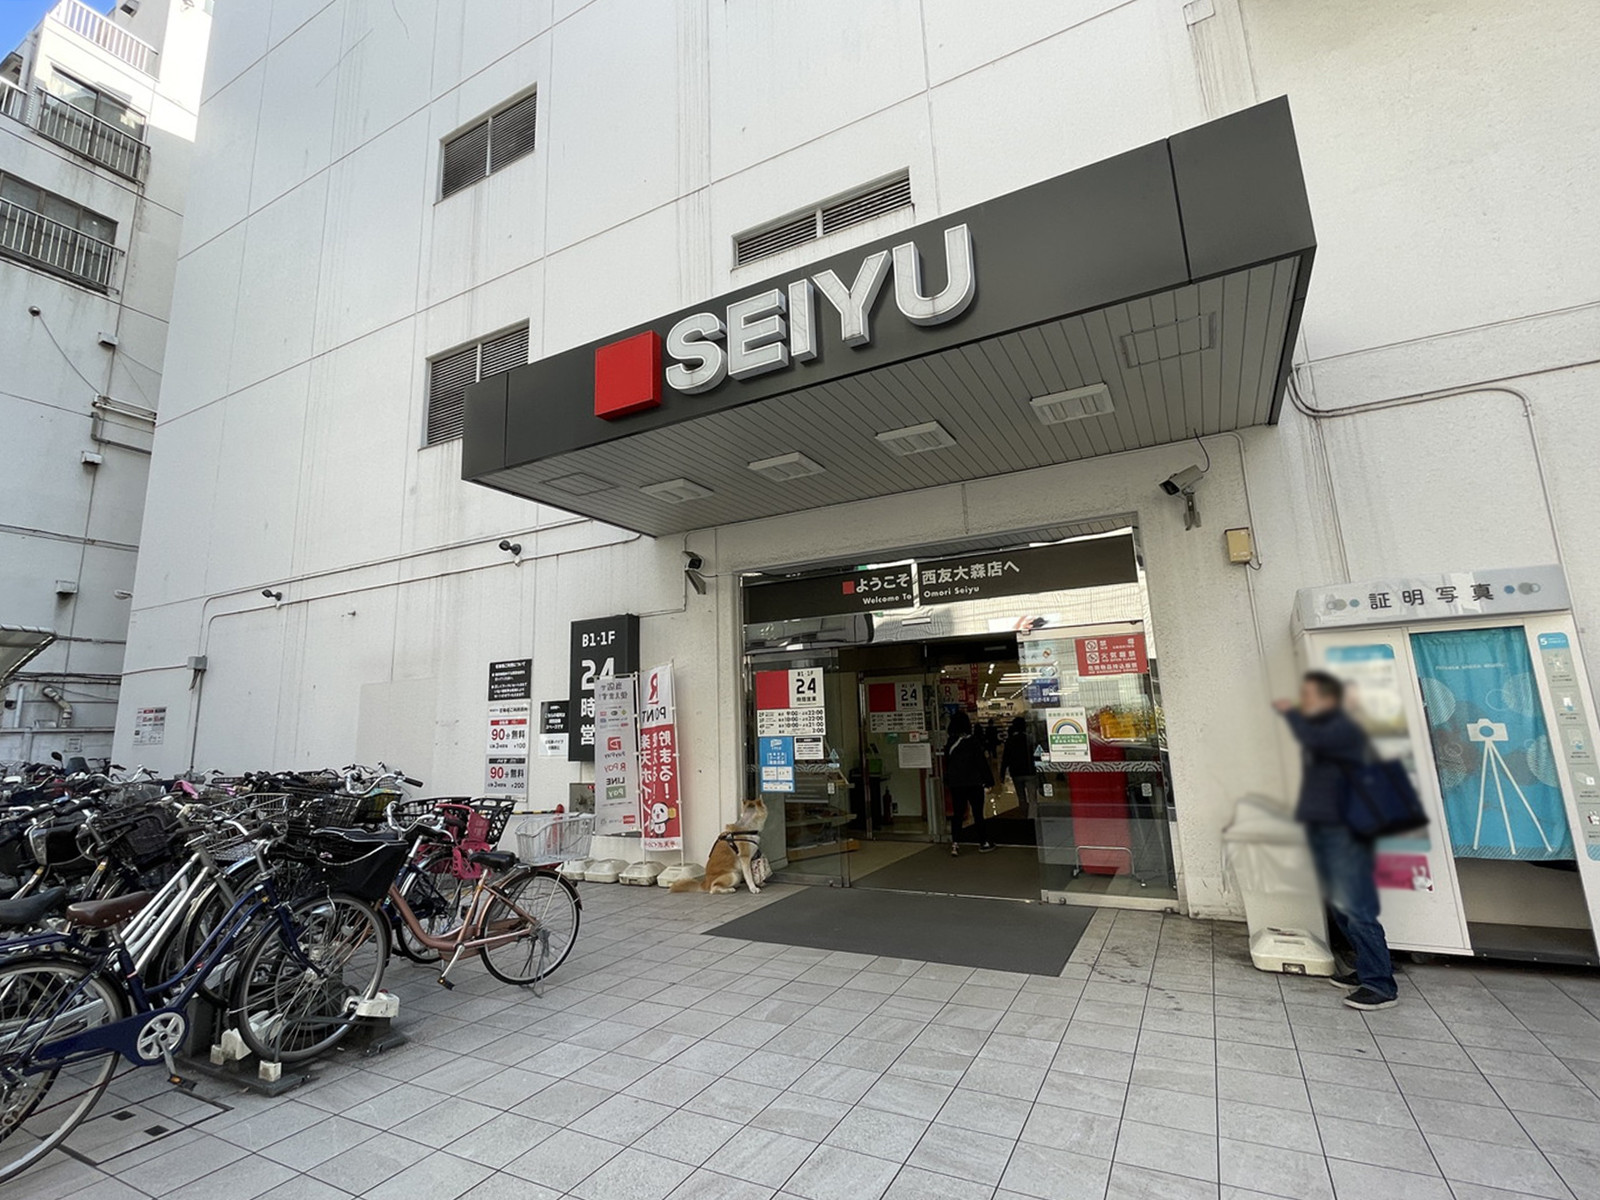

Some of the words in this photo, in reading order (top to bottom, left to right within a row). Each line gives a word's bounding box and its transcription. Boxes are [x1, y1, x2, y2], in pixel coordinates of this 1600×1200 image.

[666, 223, 976, 395] SEIYU
[855, 572, 910, 593] ようこそ
[921, 561, 1020, 586] 西友大森店へ
[862, 596, 900, 605] Welcome
[923, 588, 951, 598] Omori
[954, 585, 980, 594] Seiyu
[1368, 582, 1494, 610] 証明写真
[796, 677, 816, 694] 24
[901, 689, 917, 701] 24
